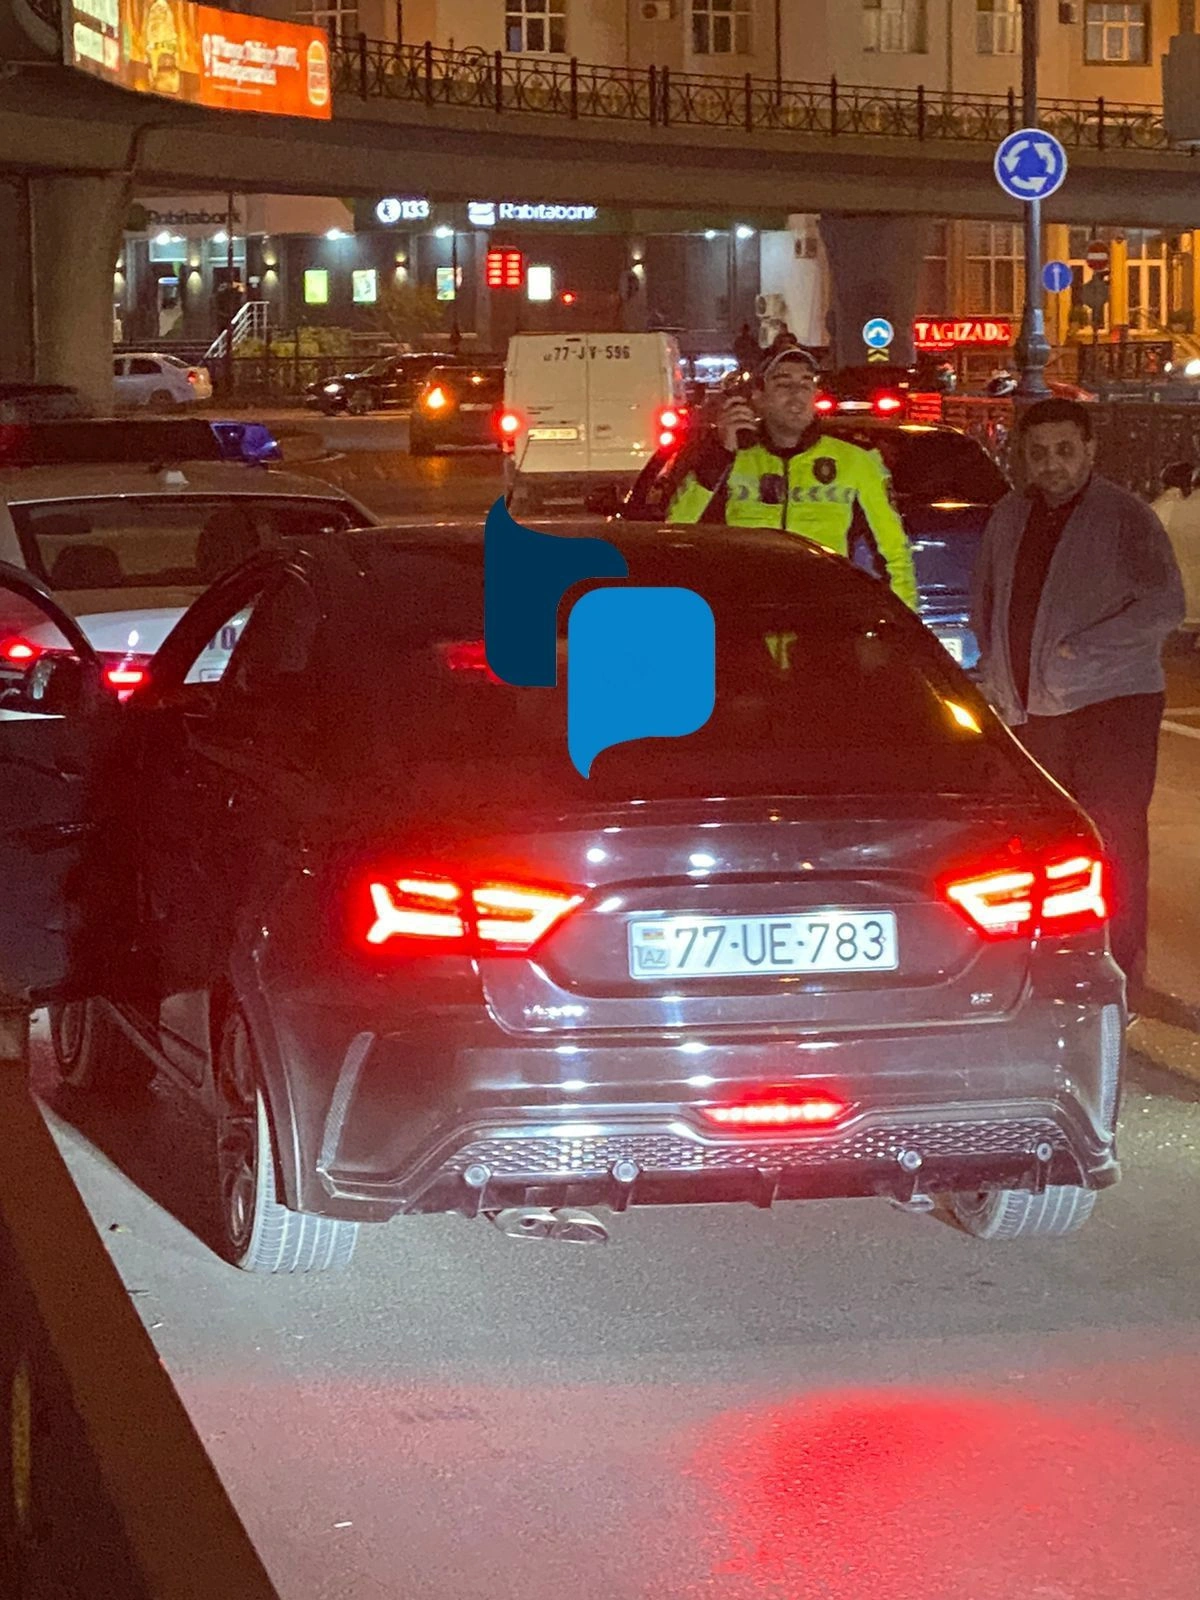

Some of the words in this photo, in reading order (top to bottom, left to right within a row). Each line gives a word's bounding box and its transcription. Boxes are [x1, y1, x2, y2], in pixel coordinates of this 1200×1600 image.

[402, 200, 430, 218] 133
[500, 203, 598, 220] Rabitabank
[641, 949, 666, 965] AZ
